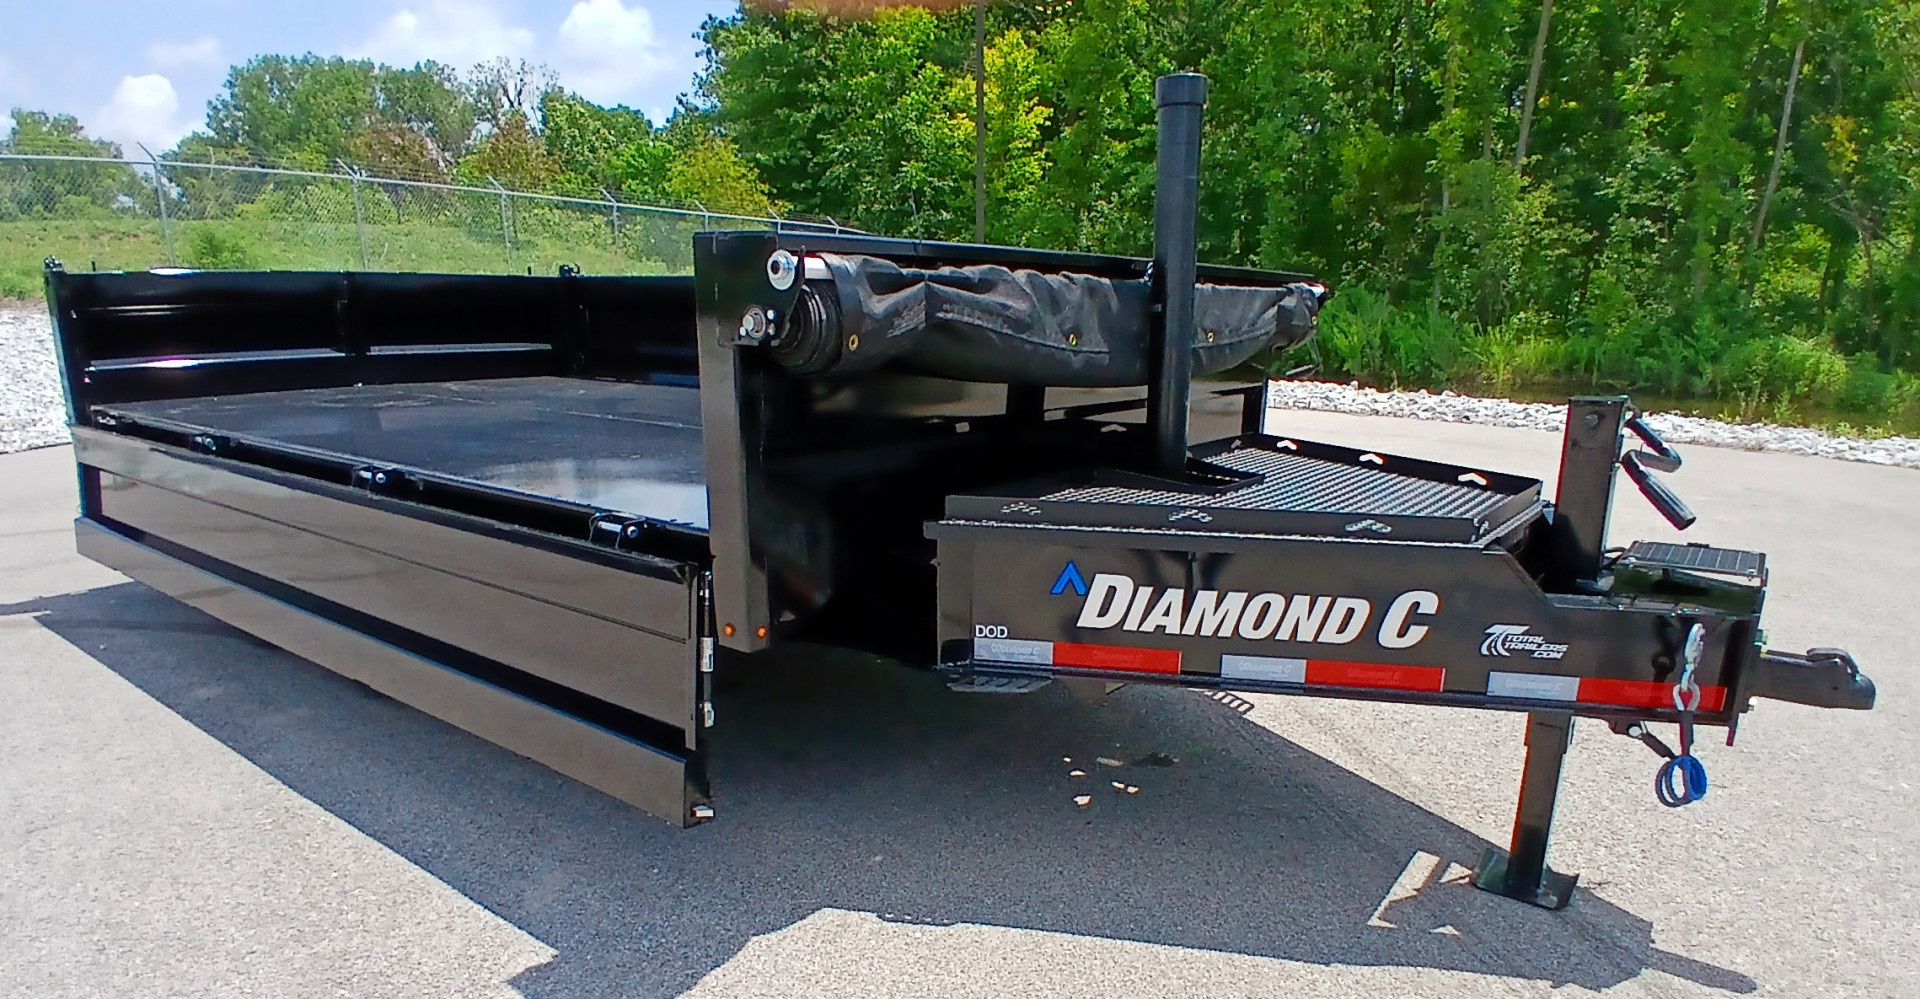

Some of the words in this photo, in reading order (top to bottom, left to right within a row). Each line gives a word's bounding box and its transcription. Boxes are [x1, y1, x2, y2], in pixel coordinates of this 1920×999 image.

[1077, 573, 1371, 645] DIAMOND
[1378, 590, 1440, 649] C
[975, 624, 1008, 638] DOD
[1506, 634, 1546, 644] TOTAL
[1504, 641, 1569, 652] TRAILERS
